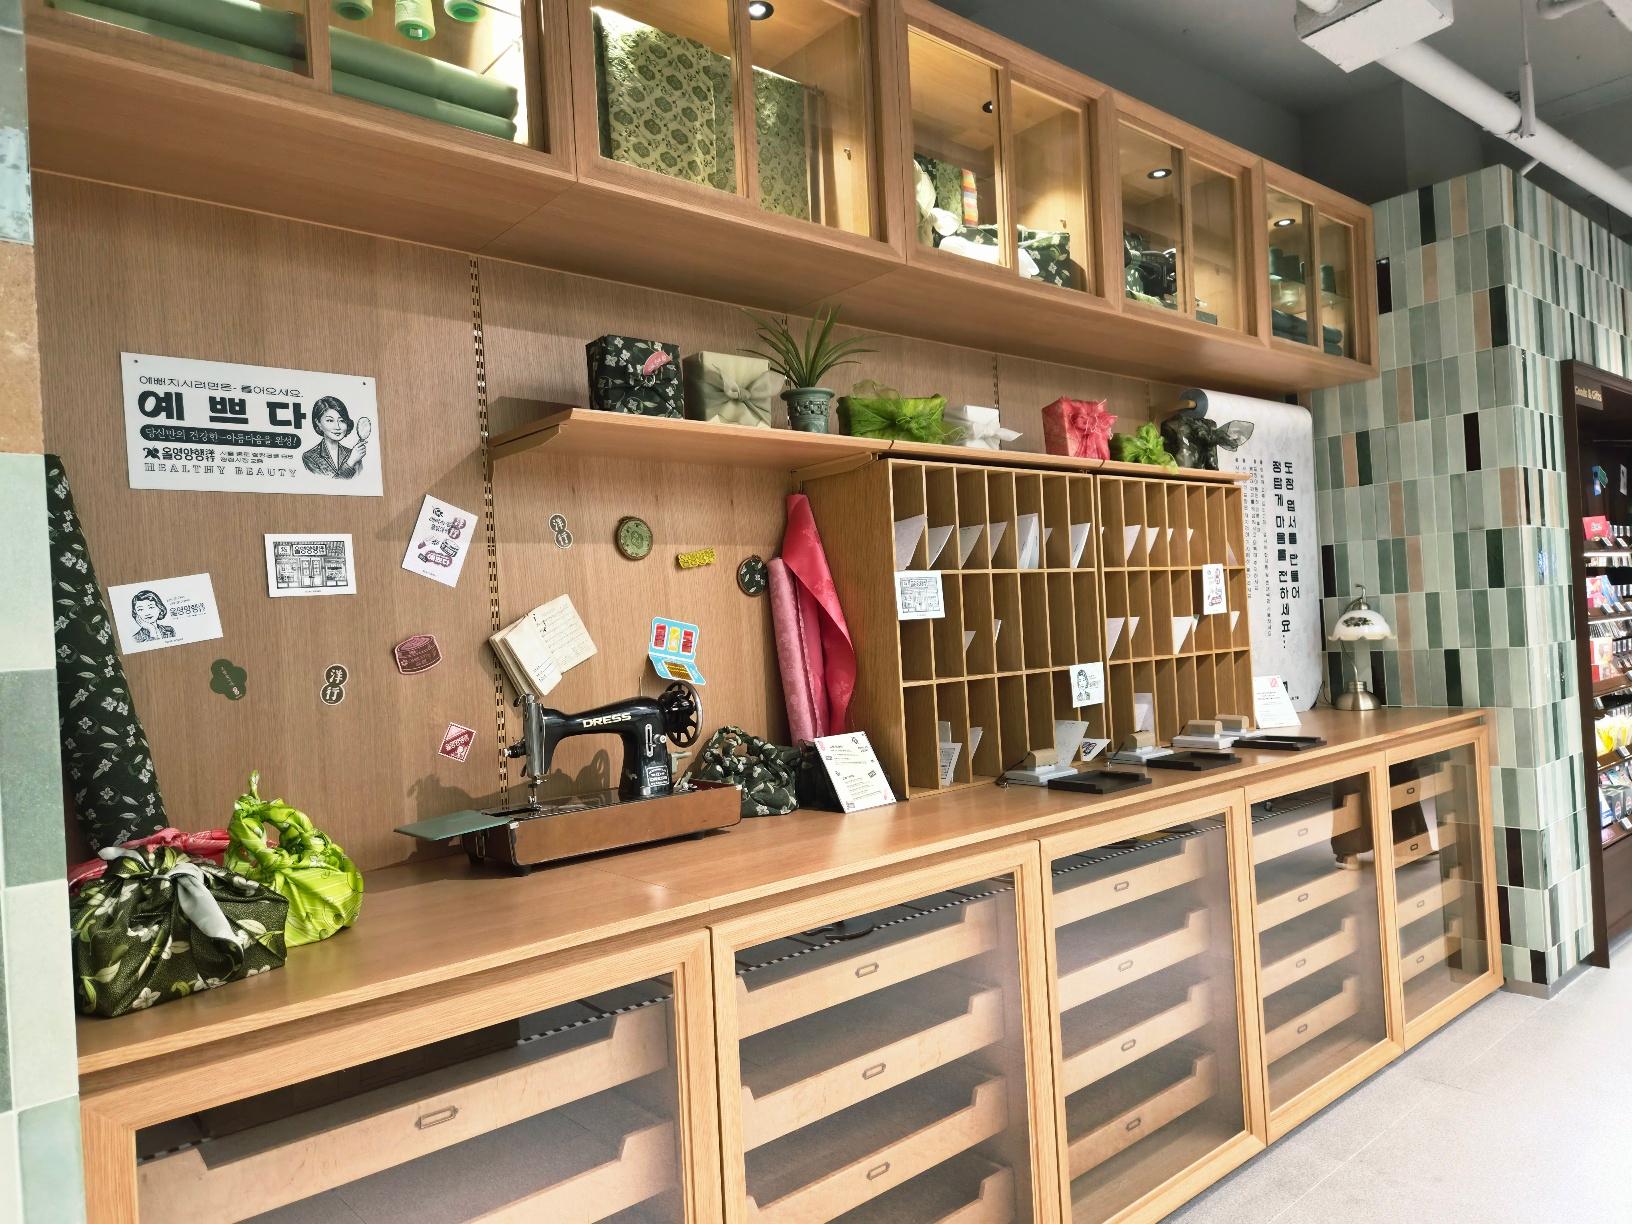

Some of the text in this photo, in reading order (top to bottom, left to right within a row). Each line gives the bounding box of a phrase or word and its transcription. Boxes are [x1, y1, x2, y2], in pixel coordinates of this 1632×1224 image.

[144, 462, 297, 478] HEALTHY BEAUTY
[325, 669, 343, 700] 洋行
[582, 712, 632, 728] DRESS
